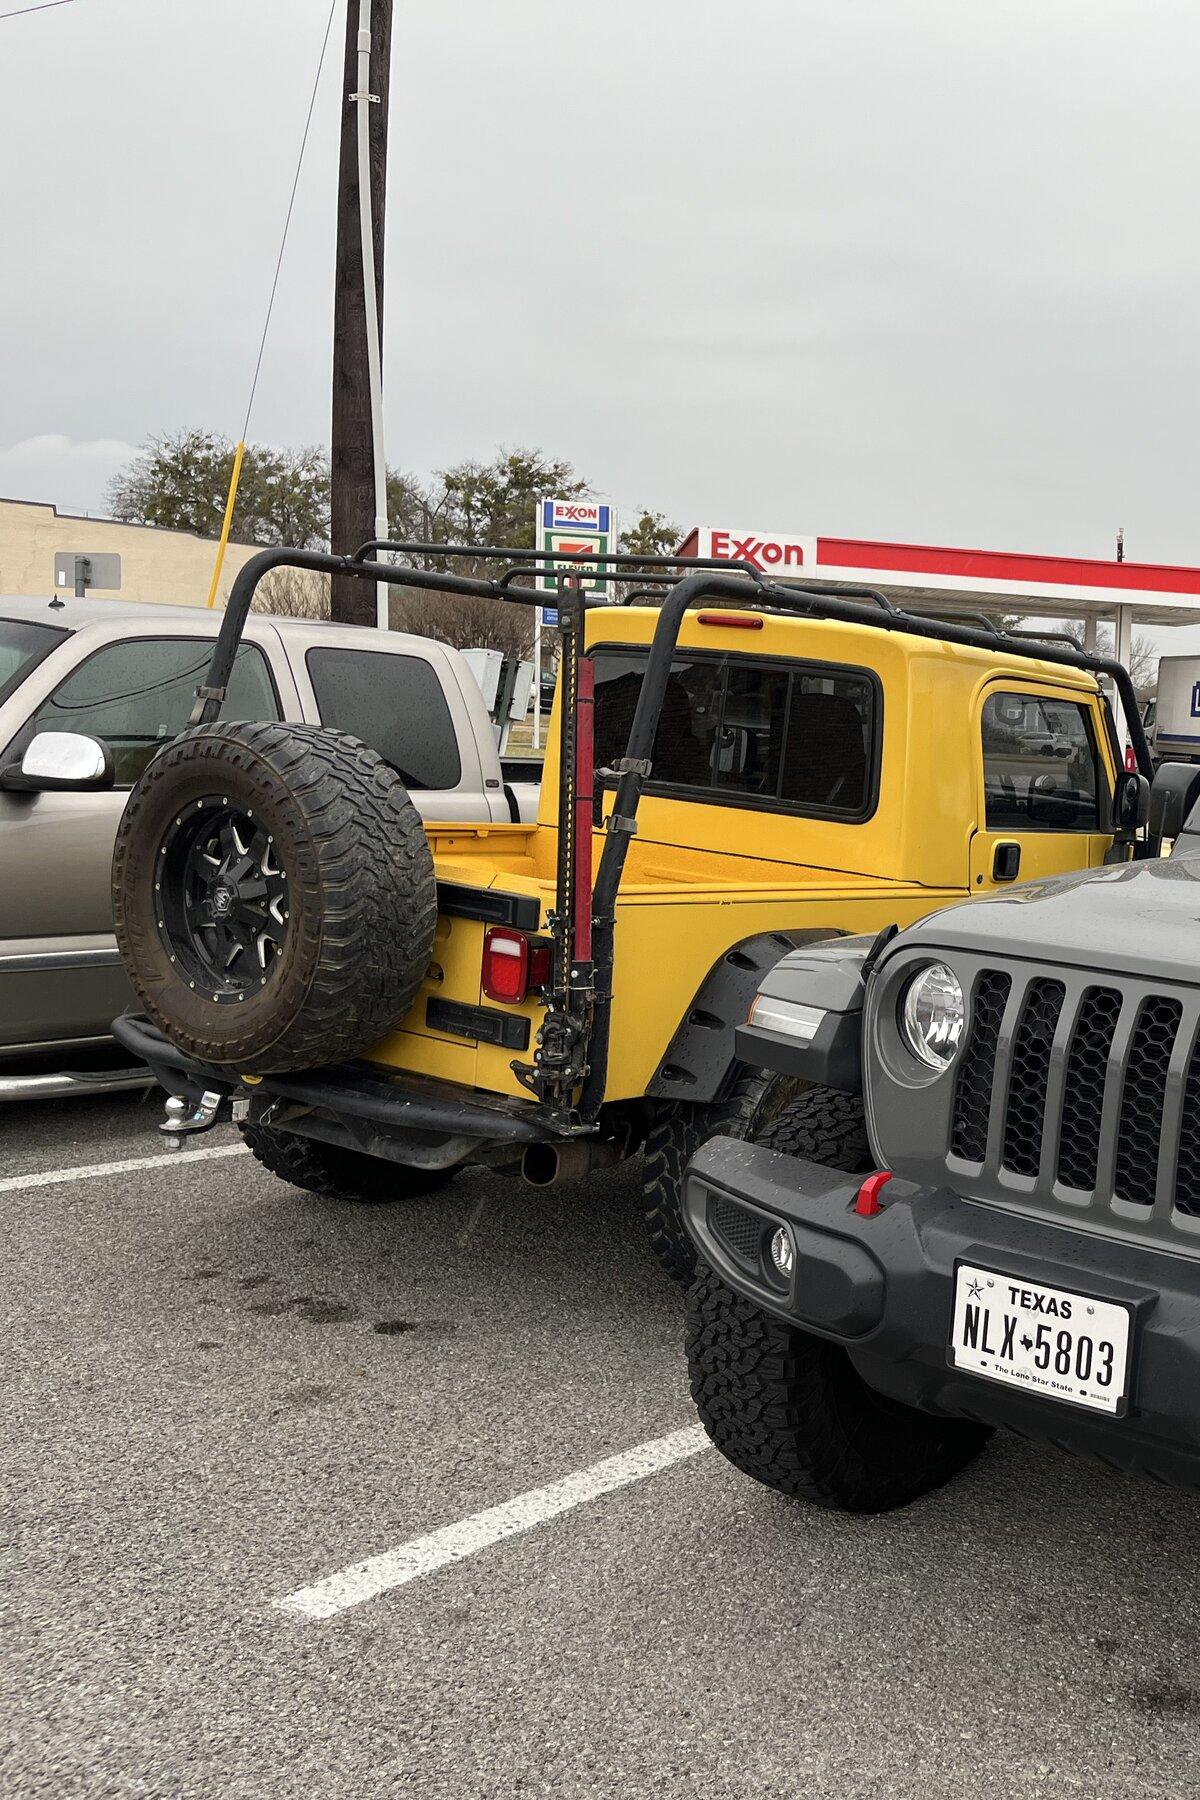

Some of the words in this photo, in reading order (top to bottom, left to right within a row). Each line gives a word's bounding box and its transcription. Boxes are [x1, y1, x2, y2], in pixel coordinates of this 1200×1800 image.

[555, 505, 597, 521] EXXON
[1008, 1286, 1072, 1320] TEXAS
[962, 1303, 1018, 1361] NLX
[1034, 1323, 1115, 1387] 5803
[995, 1364, 1009, 1374] The
[1010, 1369, 1030, 1380] Lone
[1032, 1375, 1049, 1386] Star
[1051, 1380, 1073, 1393] State
